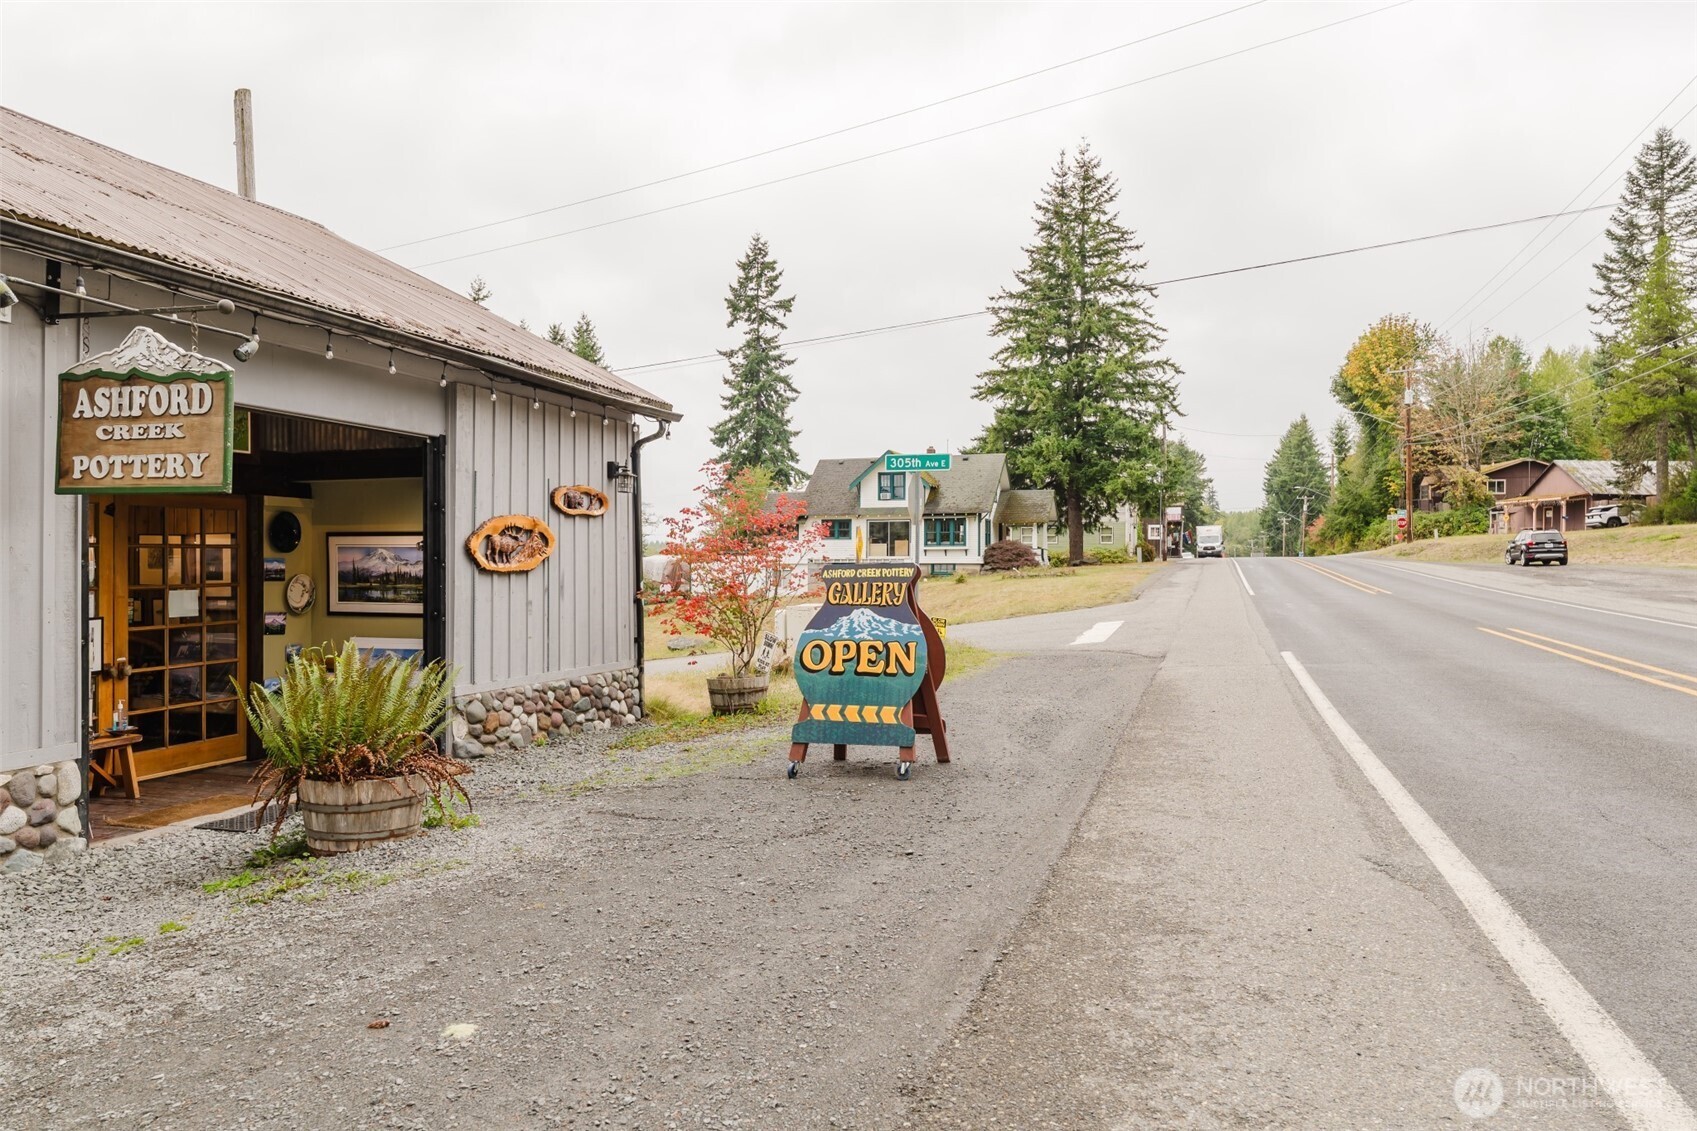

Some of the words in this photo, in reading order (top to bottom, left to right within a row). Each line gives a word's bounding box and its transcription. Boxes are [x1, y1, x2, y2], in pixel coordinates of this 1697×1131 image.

[72, 382, 213, 419] ASHFORD
[95, 422, 186, 441] CREEK
[72, 452, 210, 480] POTTERY
[890, 457, 922, 468] 305th
[925, 460, 939, 468] Ave
[822, 569, 856, 579] ASHFORD
[856, 567, 881, 578] CREEK
[882, 566, 915, 578] POTTERY
[828, 581, 907, 606] GALLERY
[800, 639, 918, 677] OPEN
